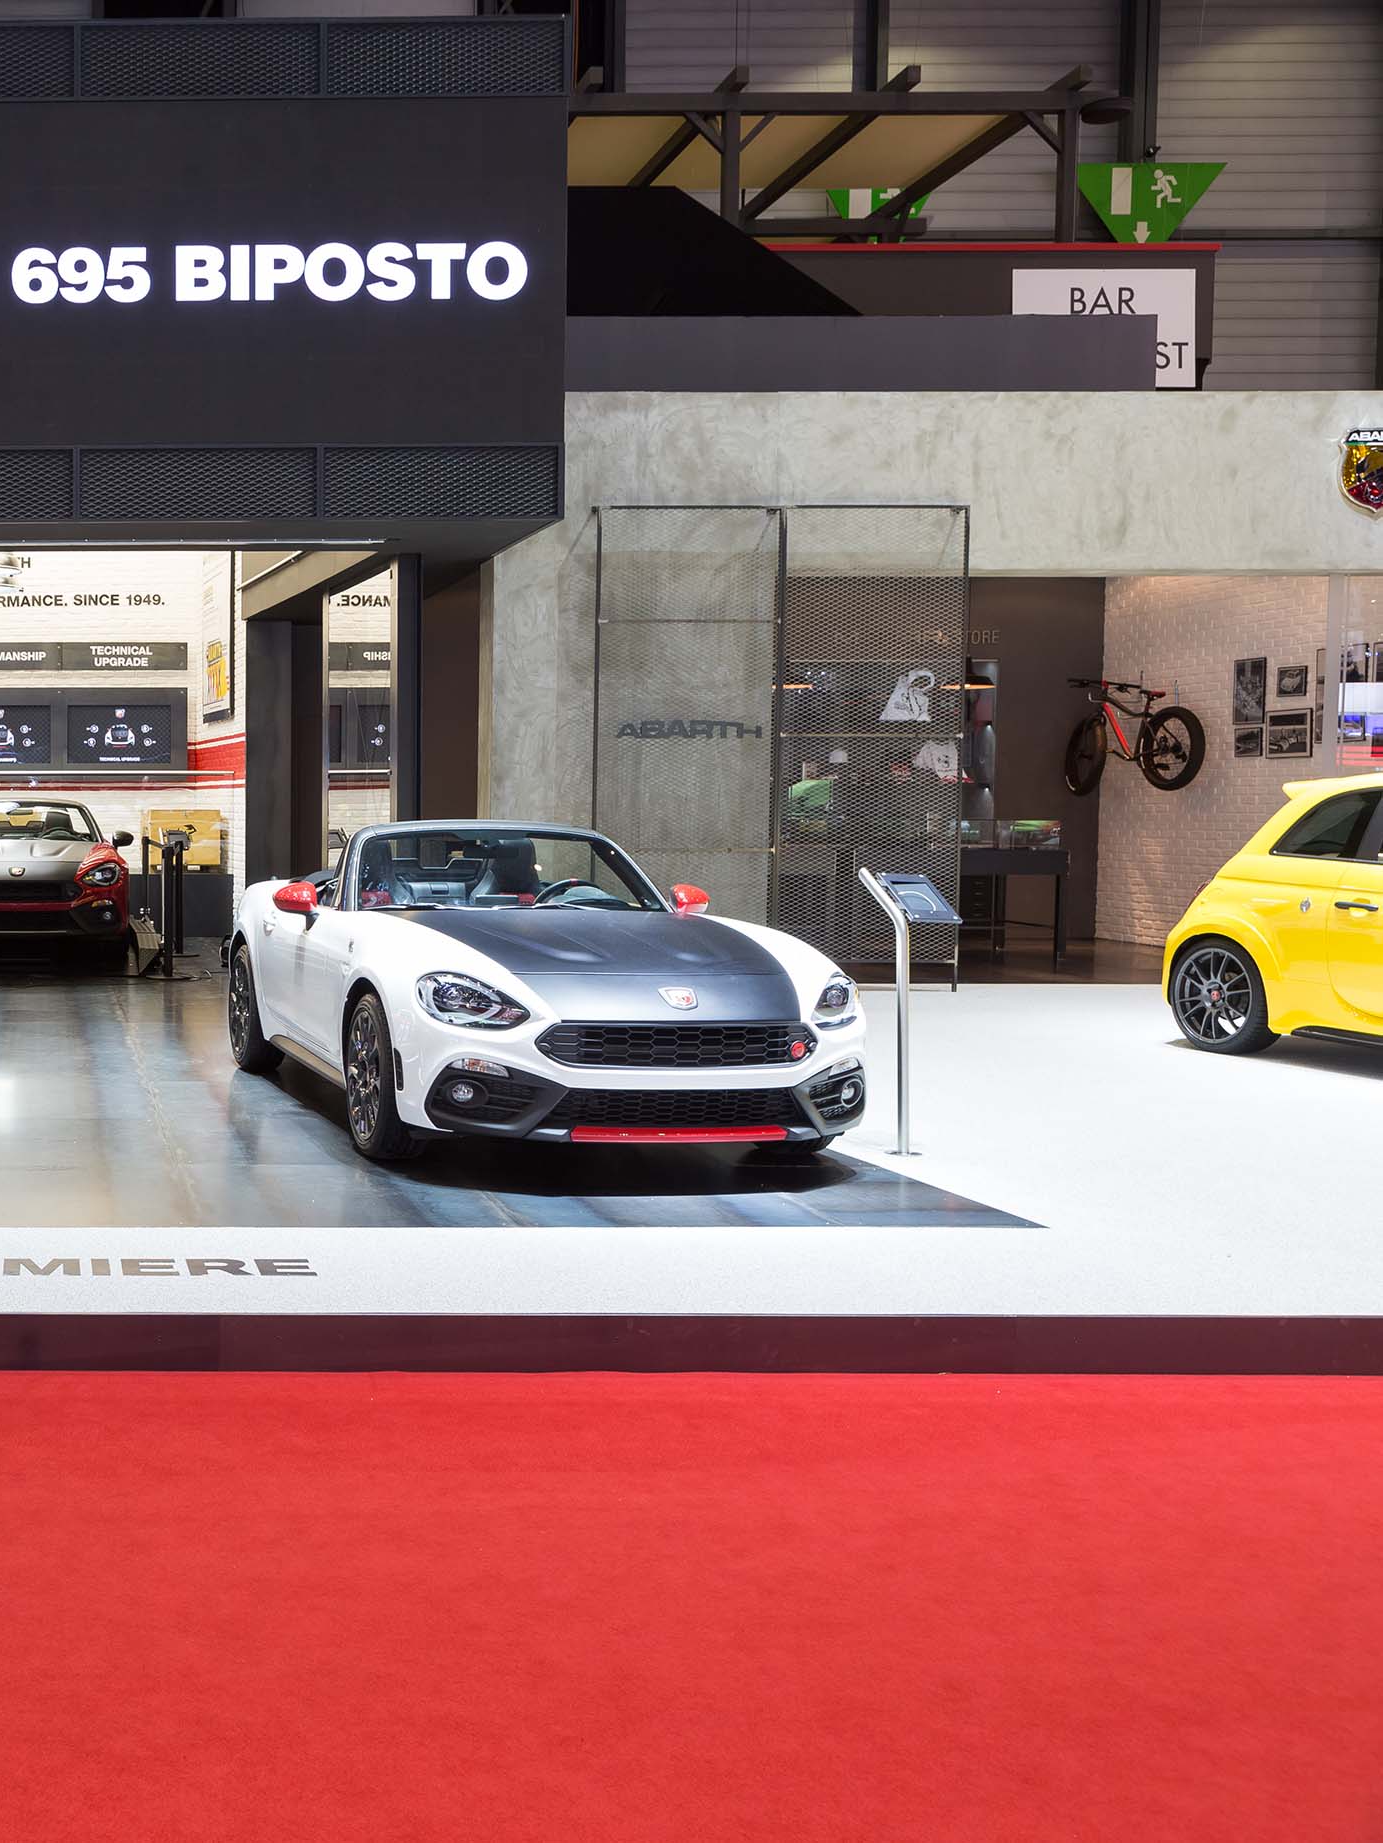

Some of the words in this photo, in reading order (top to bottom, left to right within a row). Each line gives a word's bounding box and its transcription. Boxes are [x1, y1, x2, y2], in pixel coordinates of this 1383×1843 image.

[11, 245, 152, 305] 695
[174, 240, 529, 303] BIPOSTO
[1070, 286, 1136, 314] BAR
[1348, 431, 1383, 441] ABA
[73, 594, 120, 606] SINCE
[126, 594, 165, 606] 1949.
[90, 645, 153, 656] TECHNICAL
[94, 656, 149, 667] UPGRADE
[616, 719, 763, 739] ABARTH
